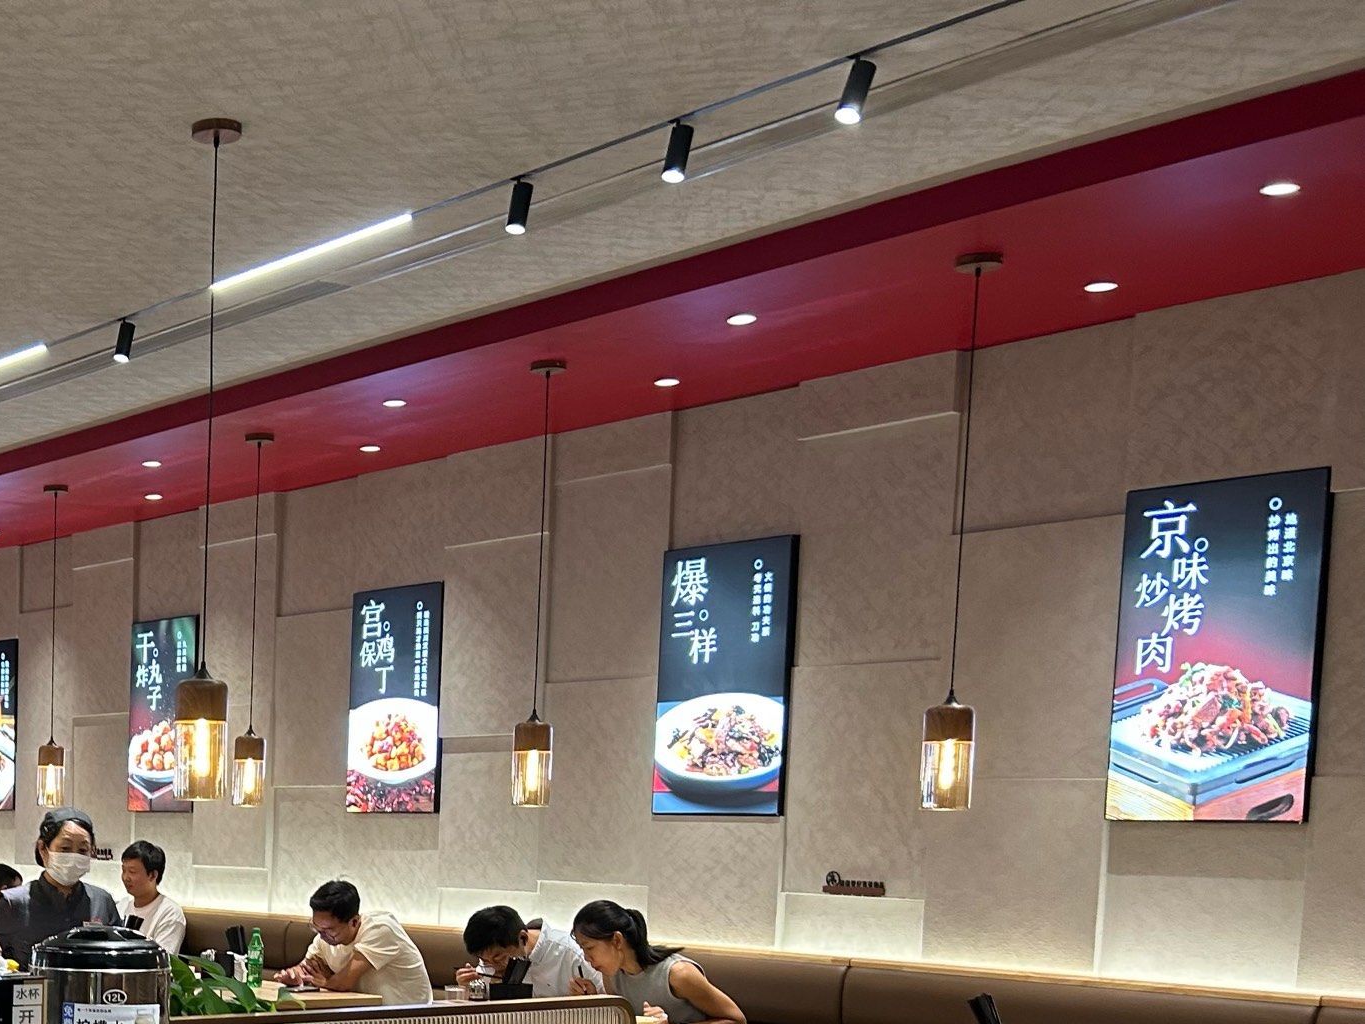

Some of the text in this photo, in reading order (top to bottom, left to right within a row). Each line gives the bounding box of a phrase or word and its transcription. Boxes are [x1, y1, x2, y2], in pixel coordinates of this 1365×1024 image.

[359, 600, 395, 694] 宫保鸡丁
[135, 631, 163, 711] 干炸丸子
[16, 988, 39, 1000] 水杯
[107, 993, 123, 1002] 12L
[19, 1010, 34, 1024] 开
